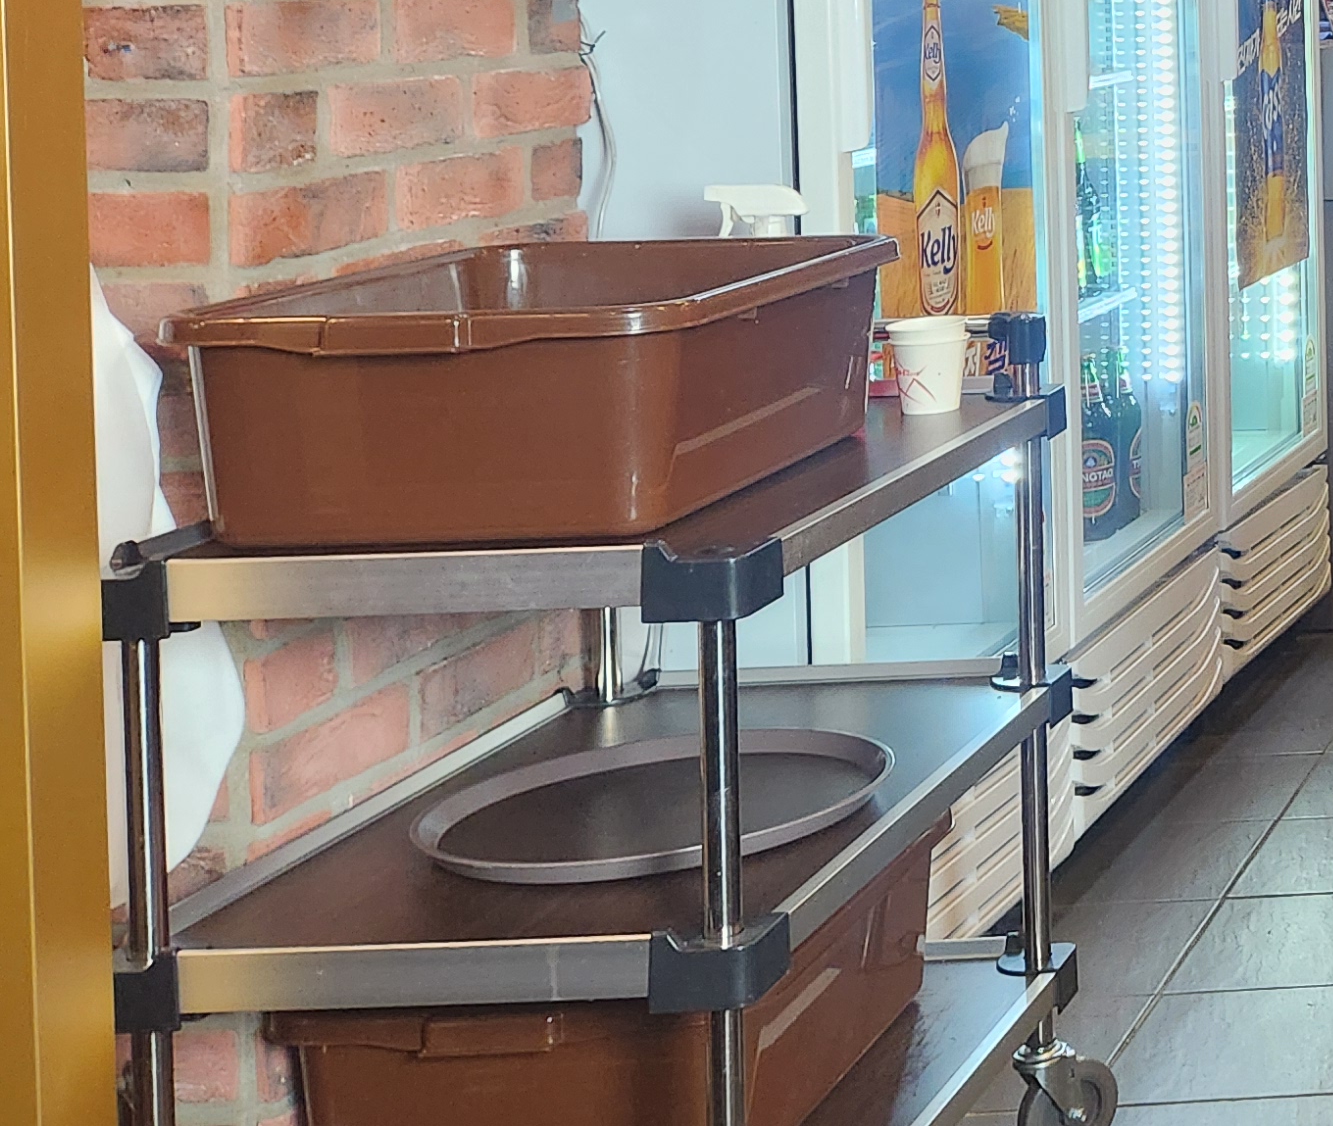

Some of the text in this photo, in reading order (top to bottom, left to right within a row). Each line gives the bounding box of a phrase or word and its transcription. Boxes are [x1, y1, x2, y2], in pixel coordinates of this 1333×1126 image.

[971, 207, 996, 238] Kelly
[920, 224, 958, 275] Kelly
[1082, 468, 1114, 482] NGTAO
